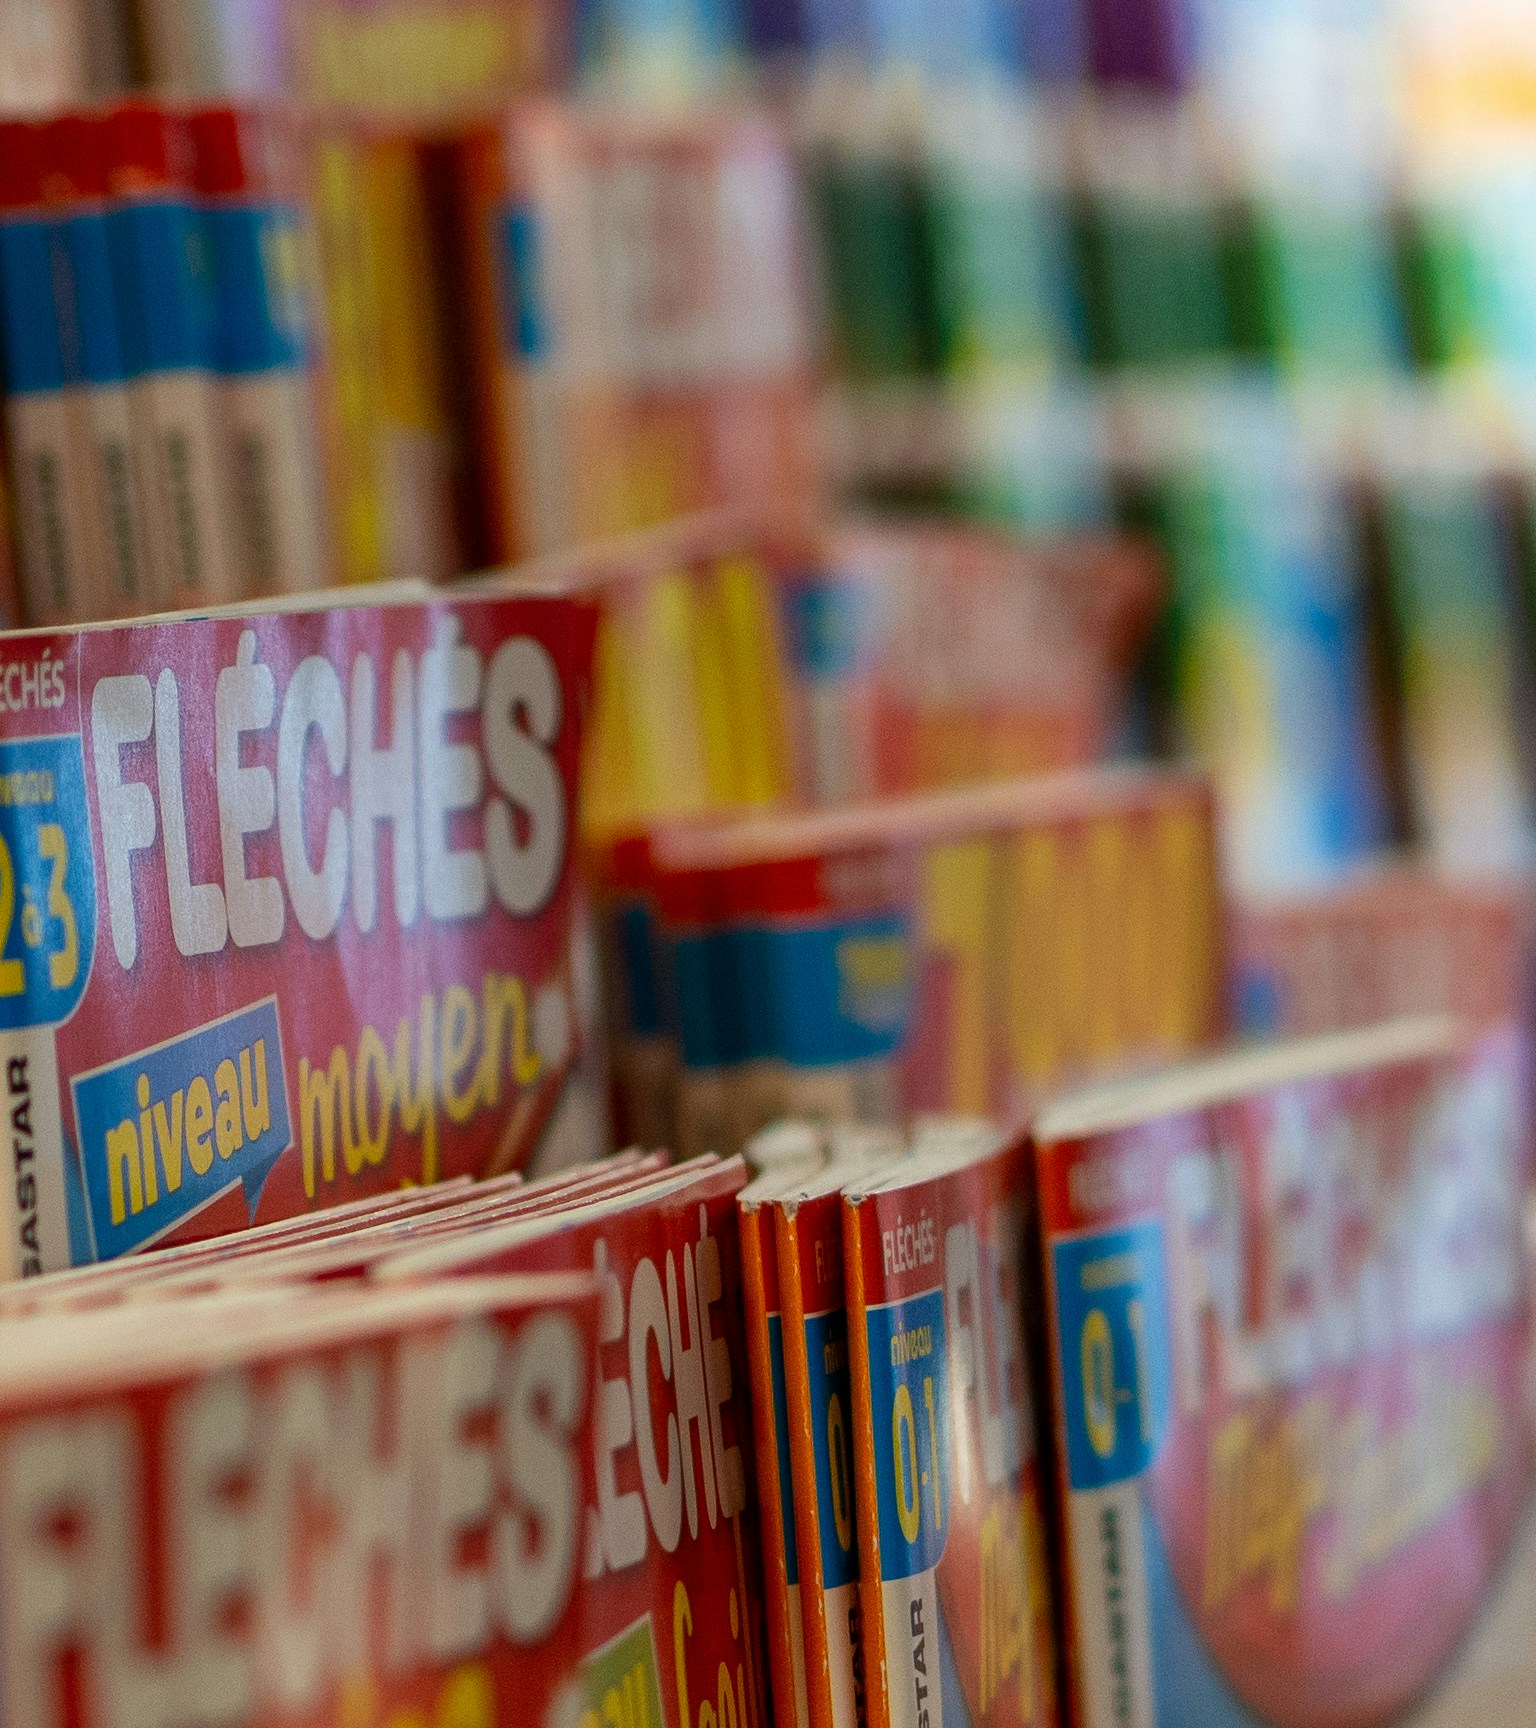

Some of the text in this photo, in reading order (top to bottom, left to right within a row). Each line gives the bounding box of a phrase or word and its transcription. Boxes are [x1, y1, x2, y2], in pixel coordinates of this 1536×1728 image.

[91, 612, 566, 972] FLÉCHÉS
[38, 824, 79, 990] 3
[105, 972, 544, 1226] niveau moyen
[882, 1210, 935, 1277] FLÉCHÉS
[891, 1325, 932, 1366] niveau
